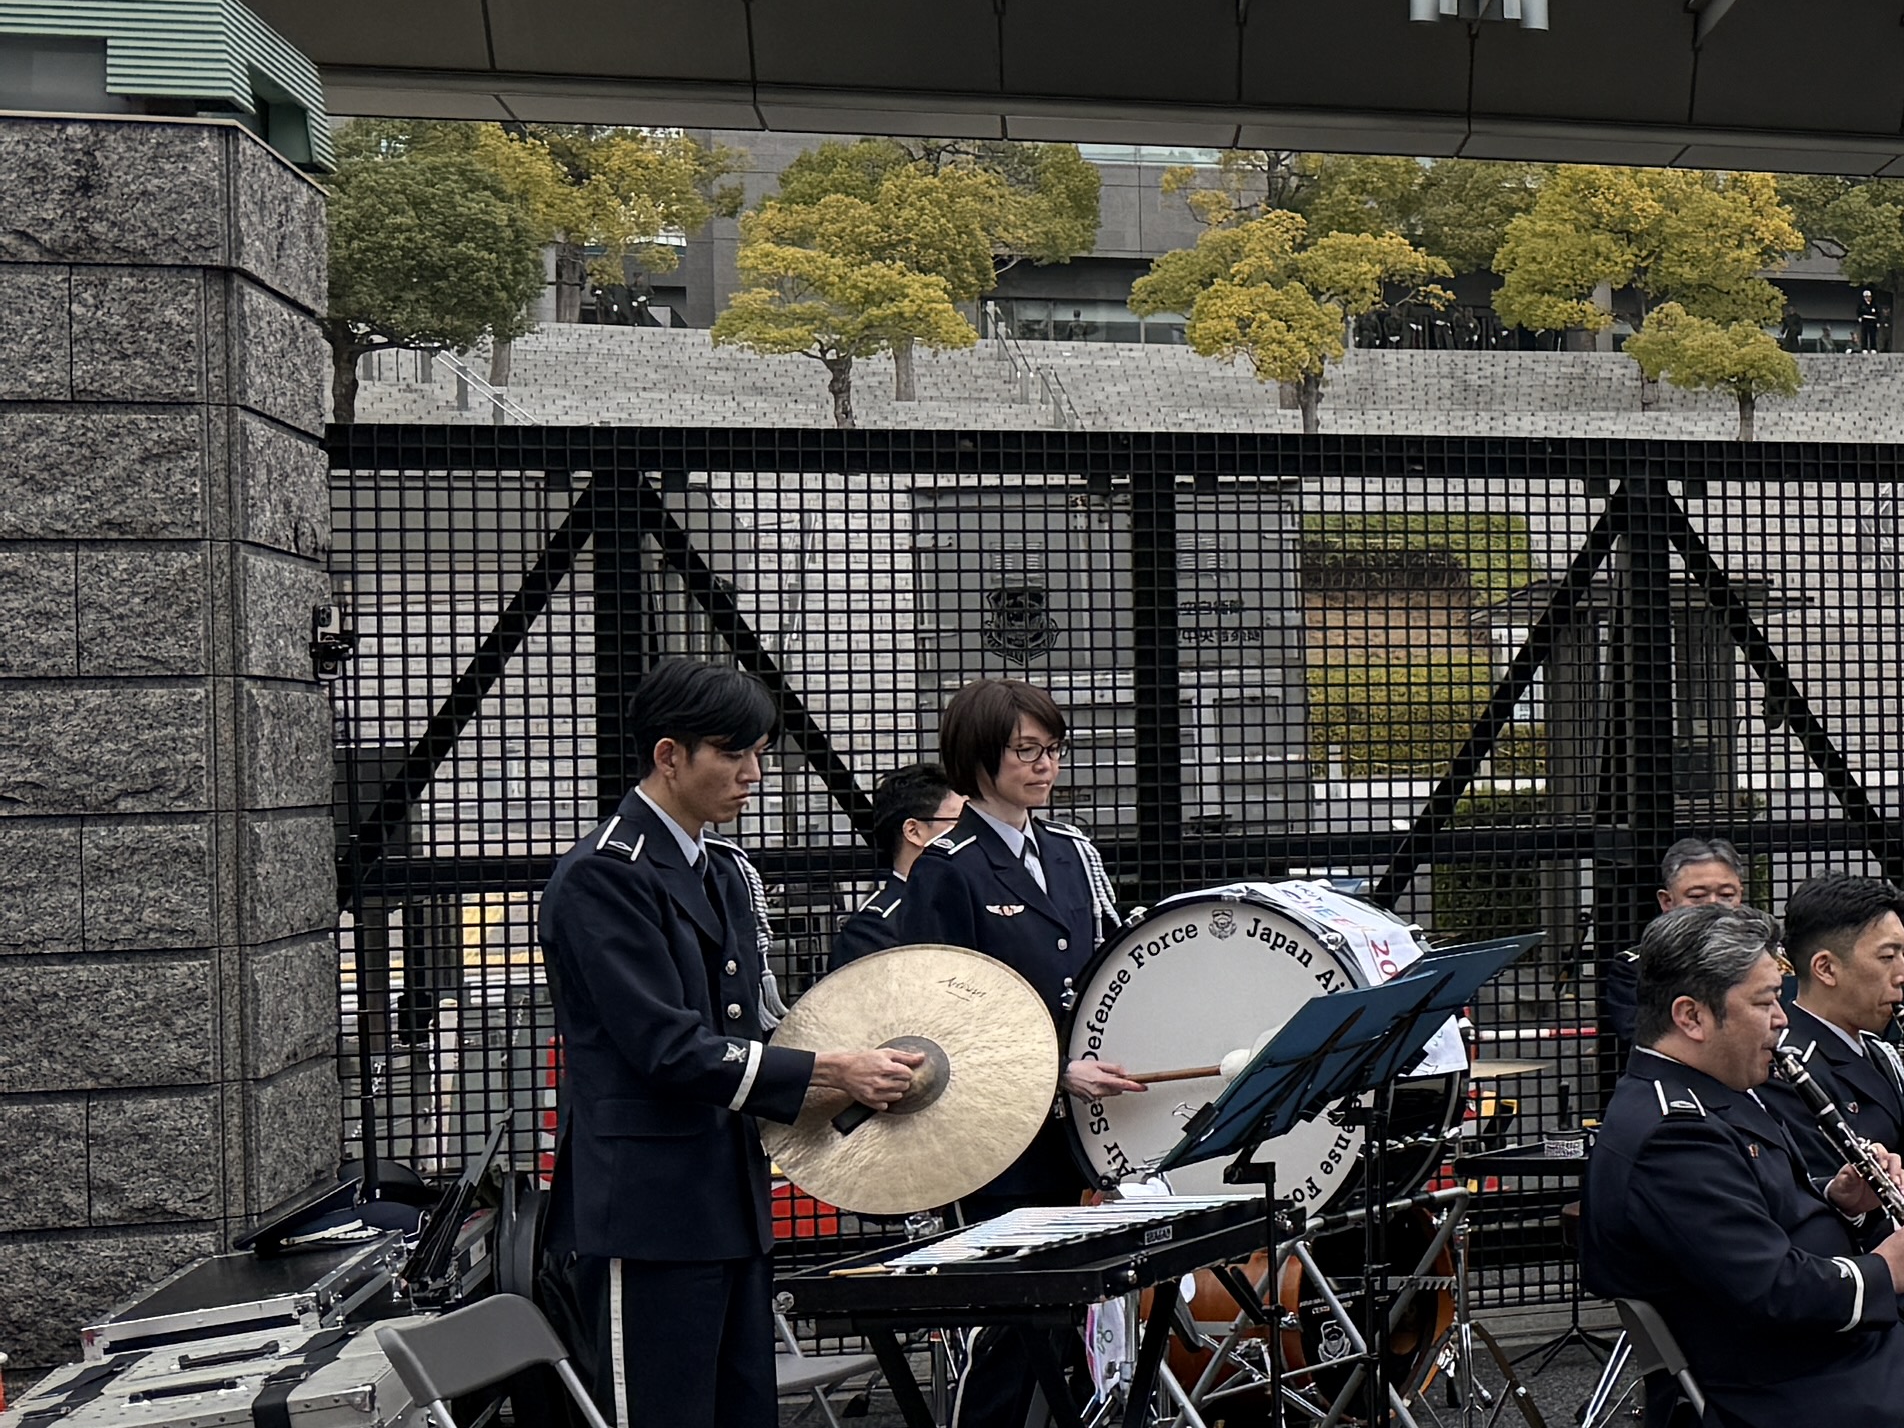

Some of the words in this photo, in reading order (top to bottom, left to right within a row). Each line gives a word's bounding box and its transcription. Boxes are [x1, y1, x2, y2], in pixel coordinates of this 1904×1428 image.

[1128, 923, 1199, 969] Force
[1246, 917, 1313, 968] Japan
[1315, 969, 1346, 995] Ai
[1371, 940, 1398, 978] 20
[1089, 1096, 1110, 1135] Se
[1103, 1142, 1138, 1187] Air
